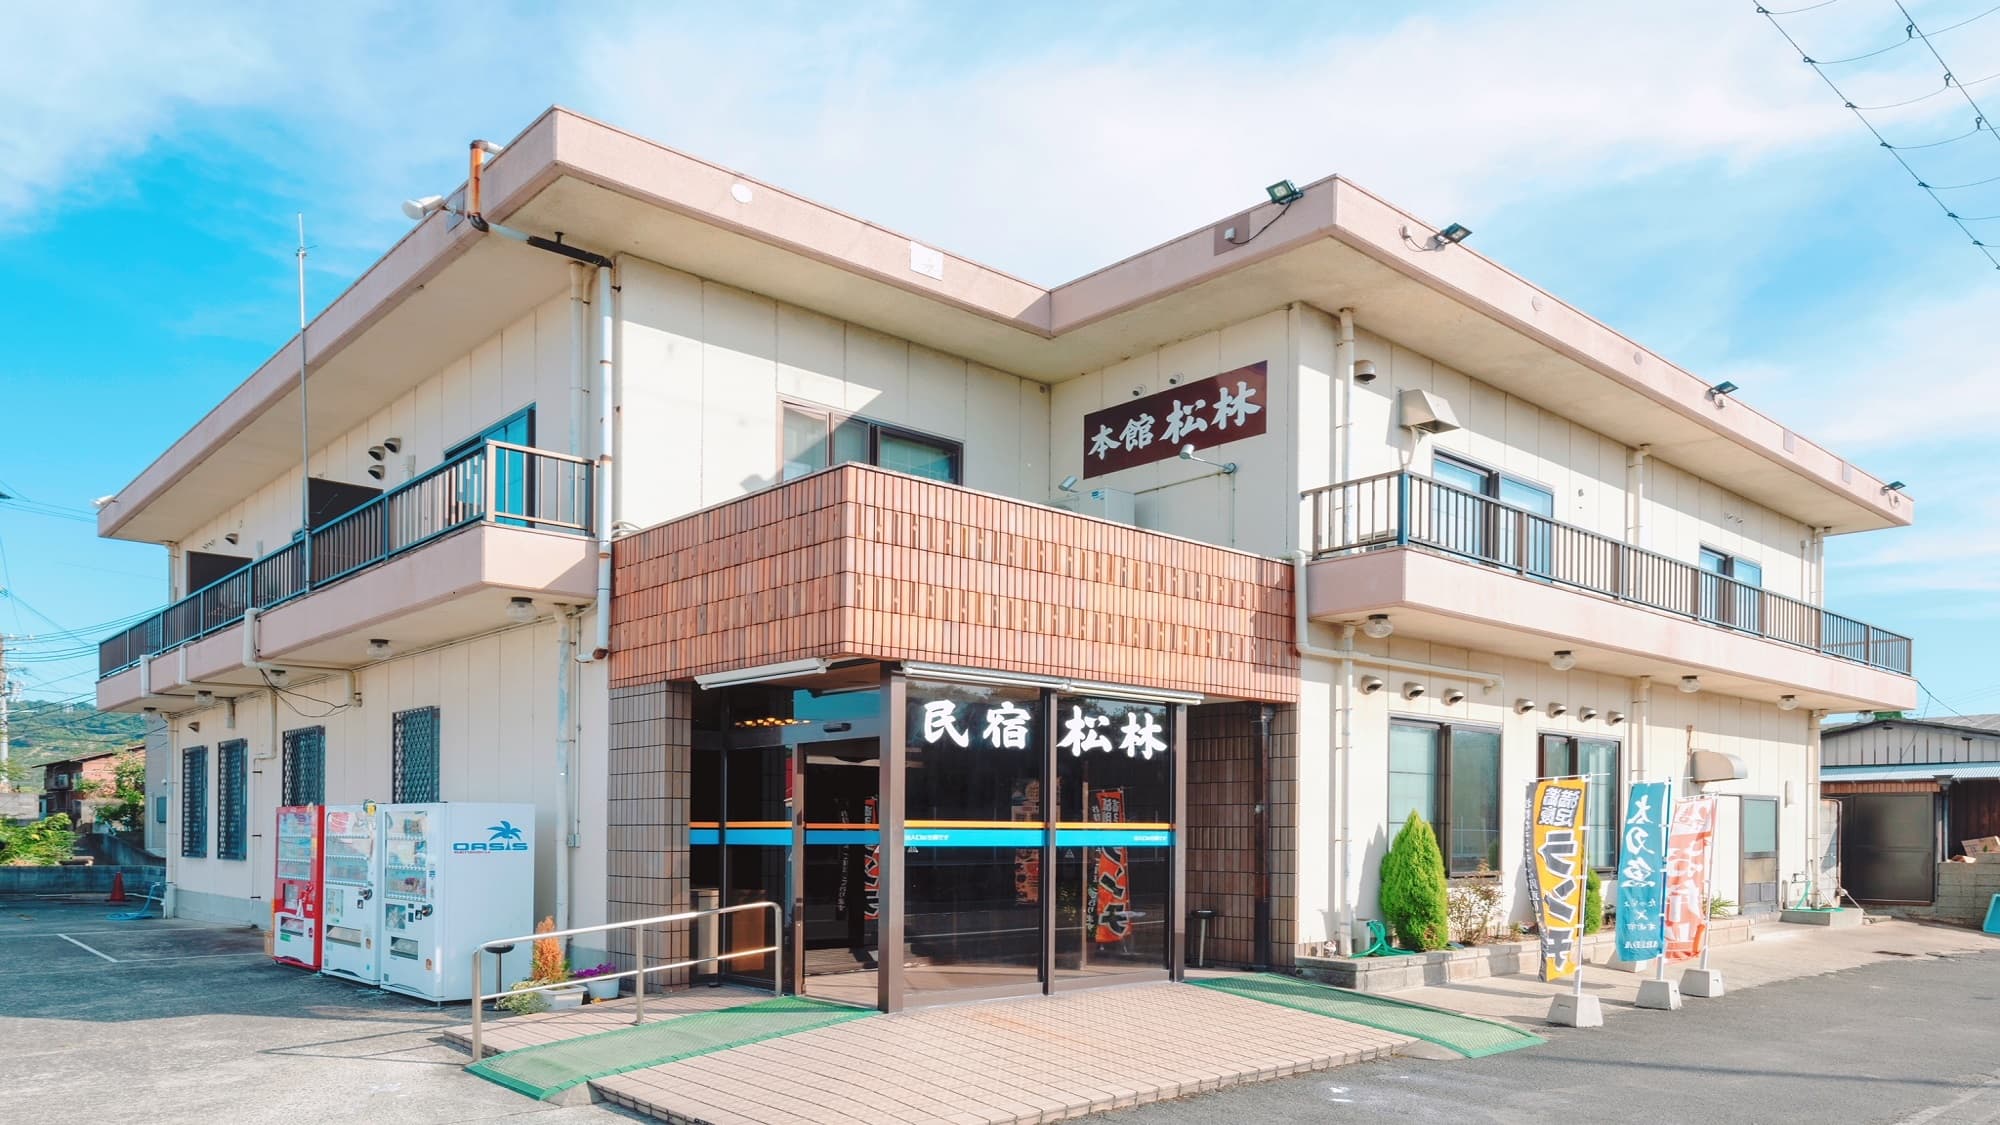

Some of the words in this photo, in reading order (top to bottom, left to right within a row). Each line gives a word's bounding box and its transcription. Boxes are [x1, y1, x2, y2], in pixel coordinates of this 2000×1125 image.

[1088, 412, 1156, 461] 本館
[1159, 381, 1261, 445] 松林
[924, 698, 1032, 749] 民宿
[1056, 705, 1168, 760] 松林
[453, 842, 529, 851] OASIS
